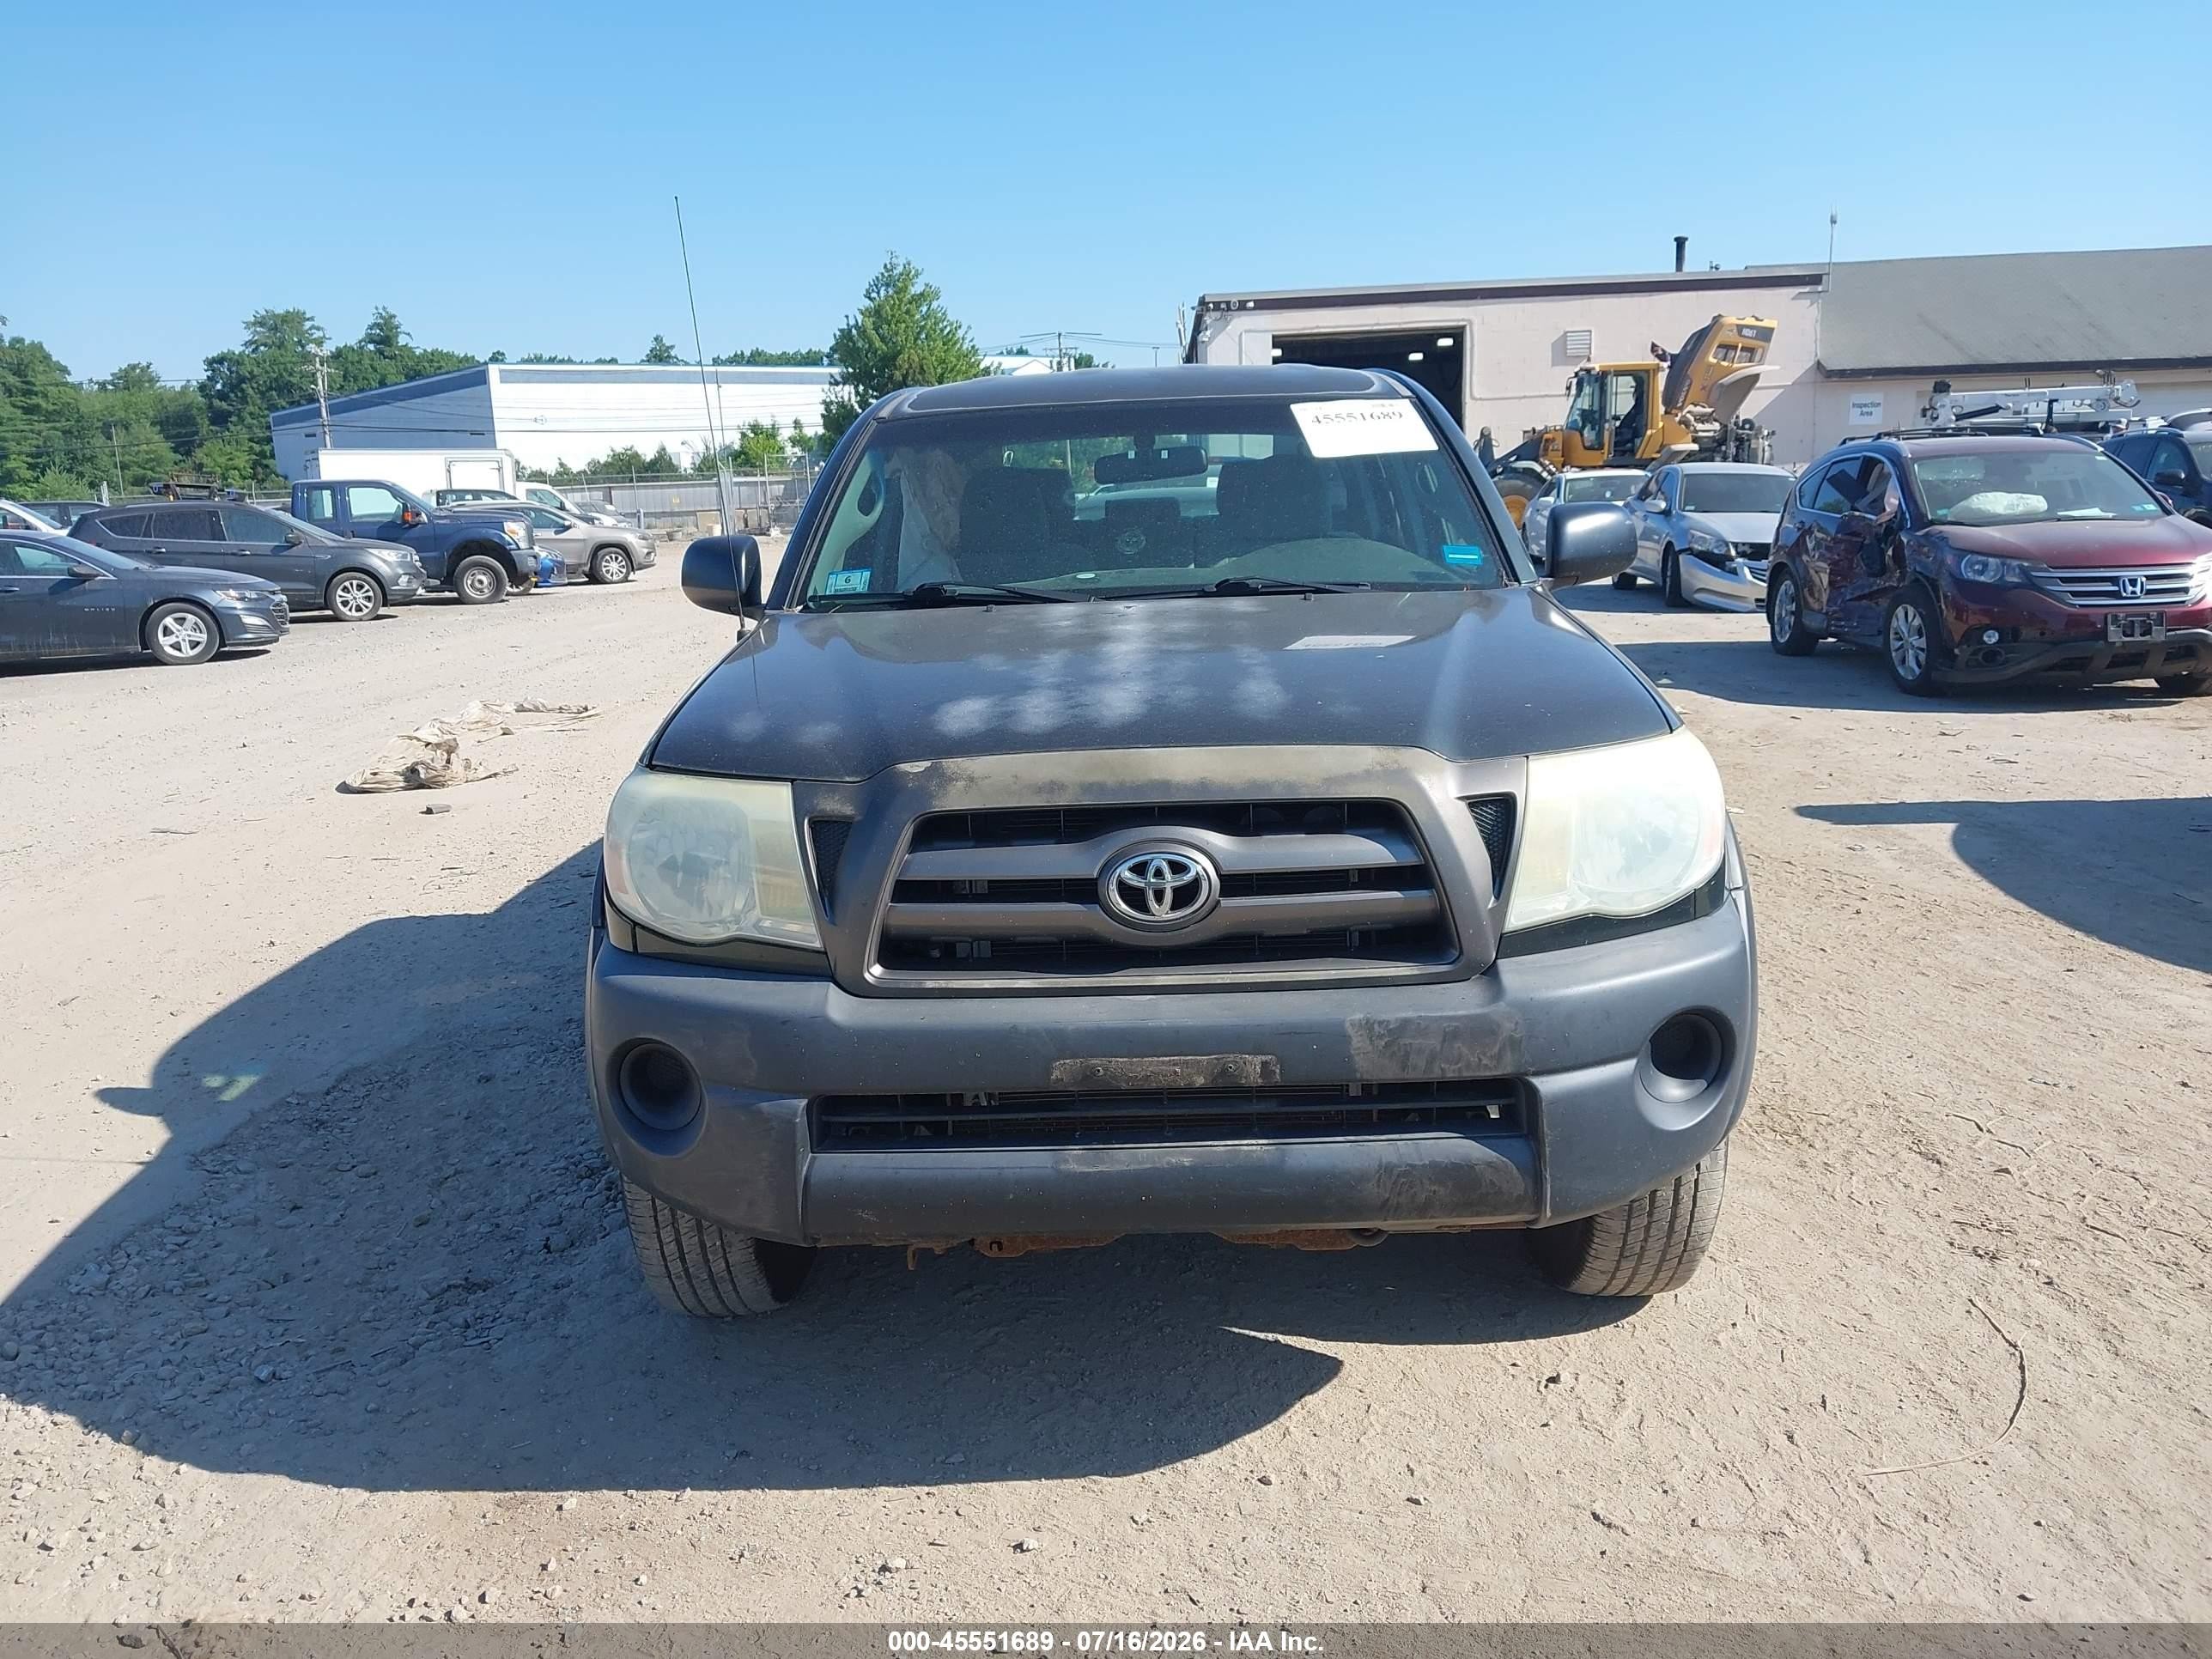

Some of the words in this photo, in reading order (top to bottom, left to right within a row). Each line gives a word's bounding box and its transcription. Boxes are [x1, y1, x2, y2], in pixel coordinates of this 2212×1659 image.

[1851, 401, 1882, 410] Inspection
[1311, 410, 1403, 425] 45551689
[844, 575, 853, 584] 6
